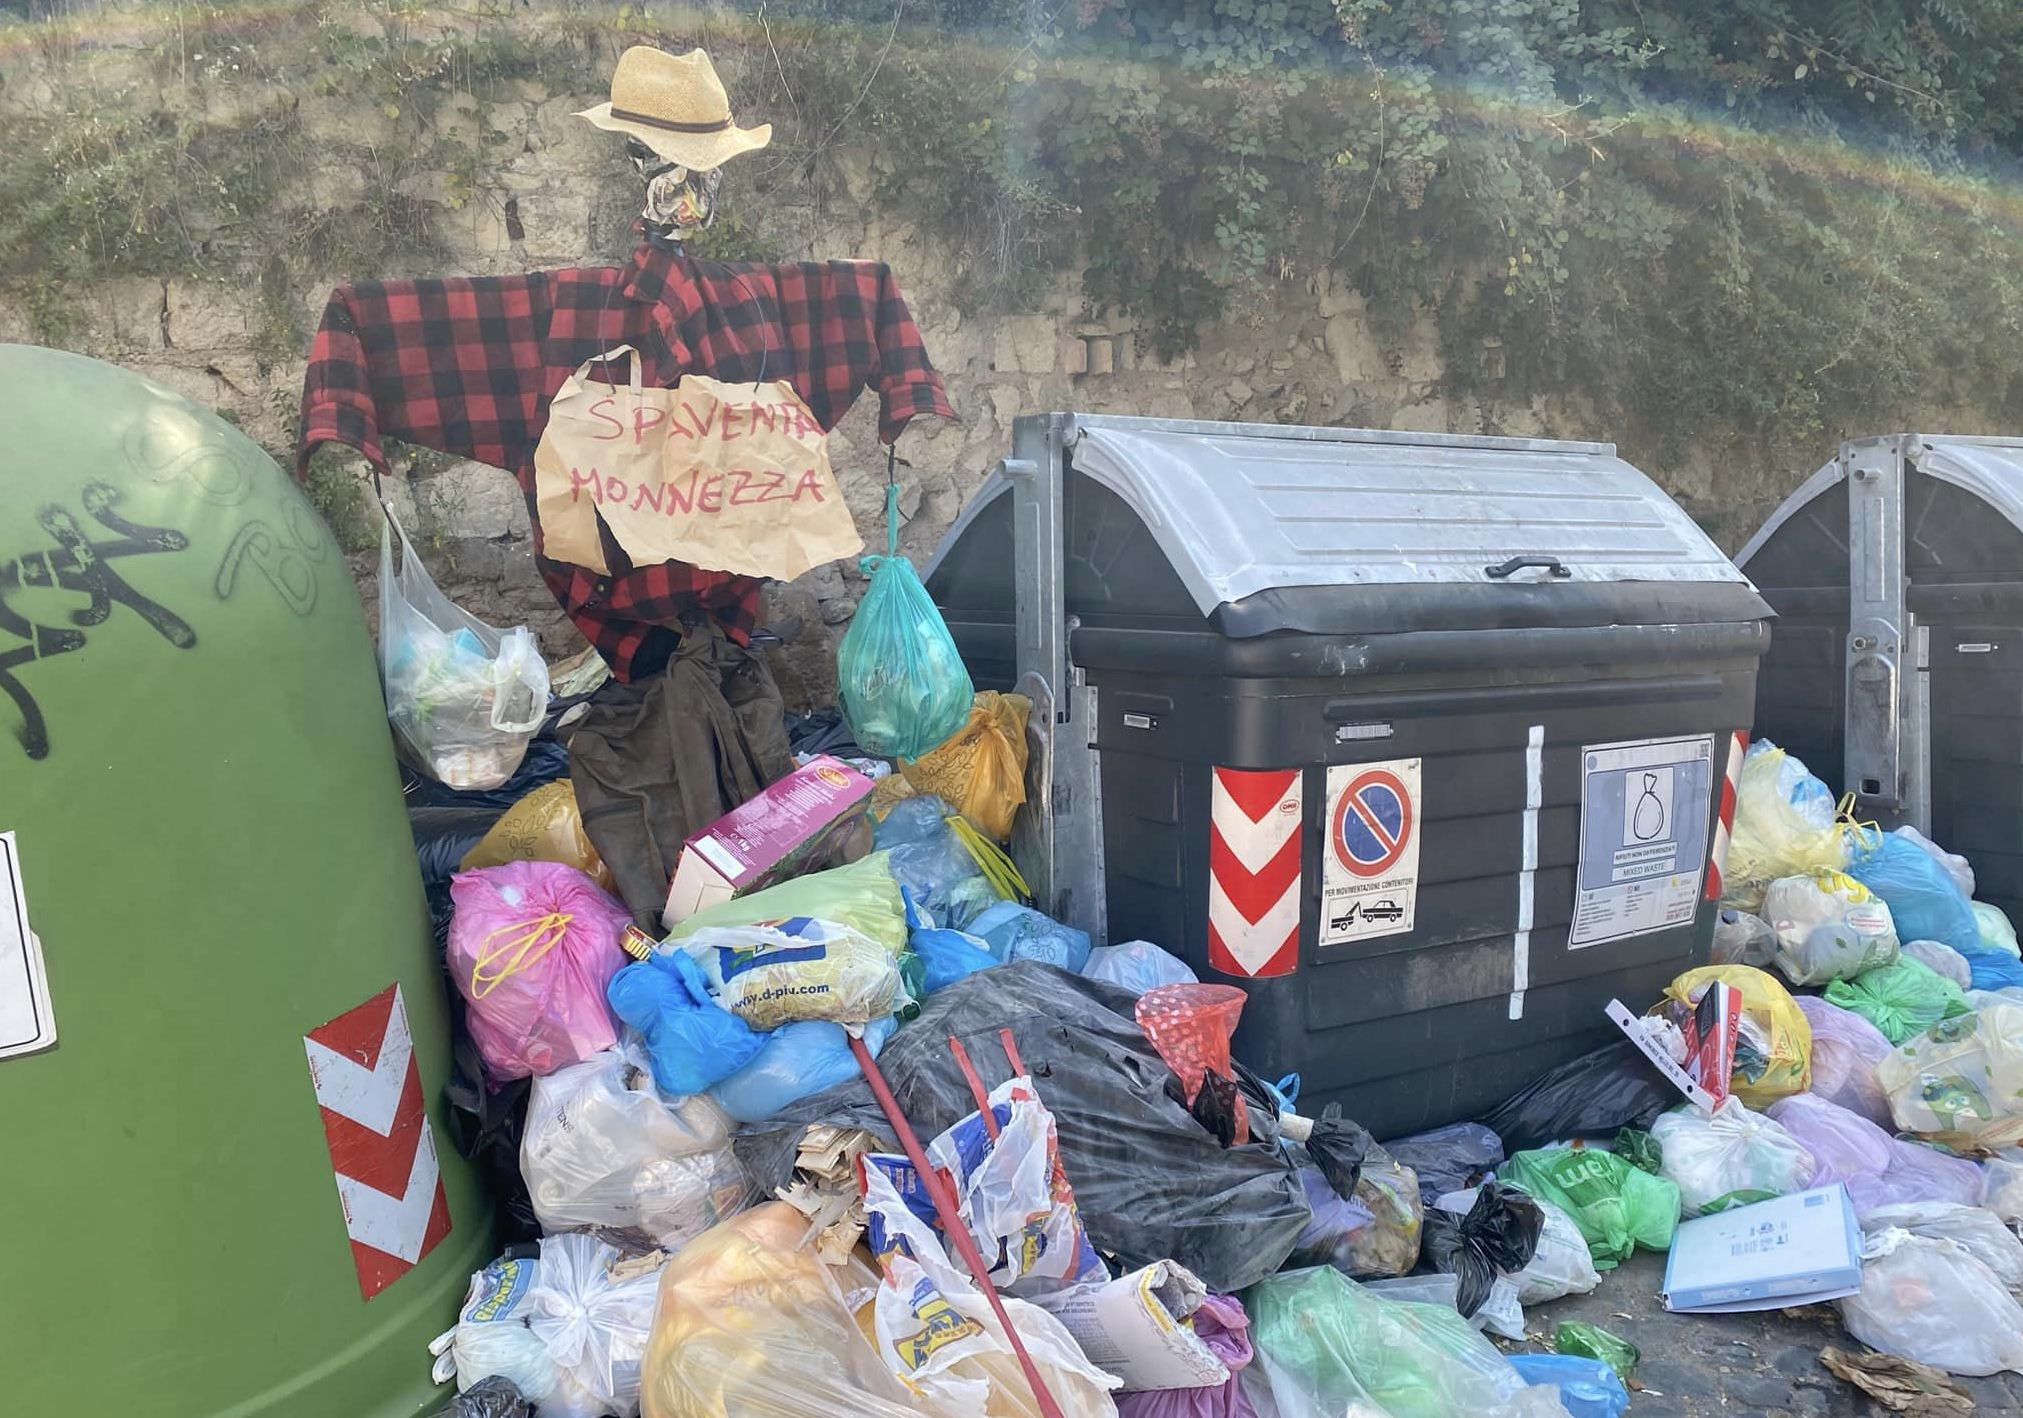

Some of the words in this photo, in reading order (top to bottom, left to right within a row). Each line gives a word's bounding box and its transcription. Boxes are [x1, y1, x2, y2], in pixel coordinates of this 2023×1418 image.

[570, 467, 826, 517] MONNEZZA
[1632, 850, 1642, 858] NON
[1623, 865, 1643, 876] MIXED
[1644, 862, 1666, 873] WASTE
[1324, 888, 1335, 897] PER
[1336, 882, 1381, 896] MOVIMENTAZIONE
[1381, 877, 1414, 889] CONTENITORI
